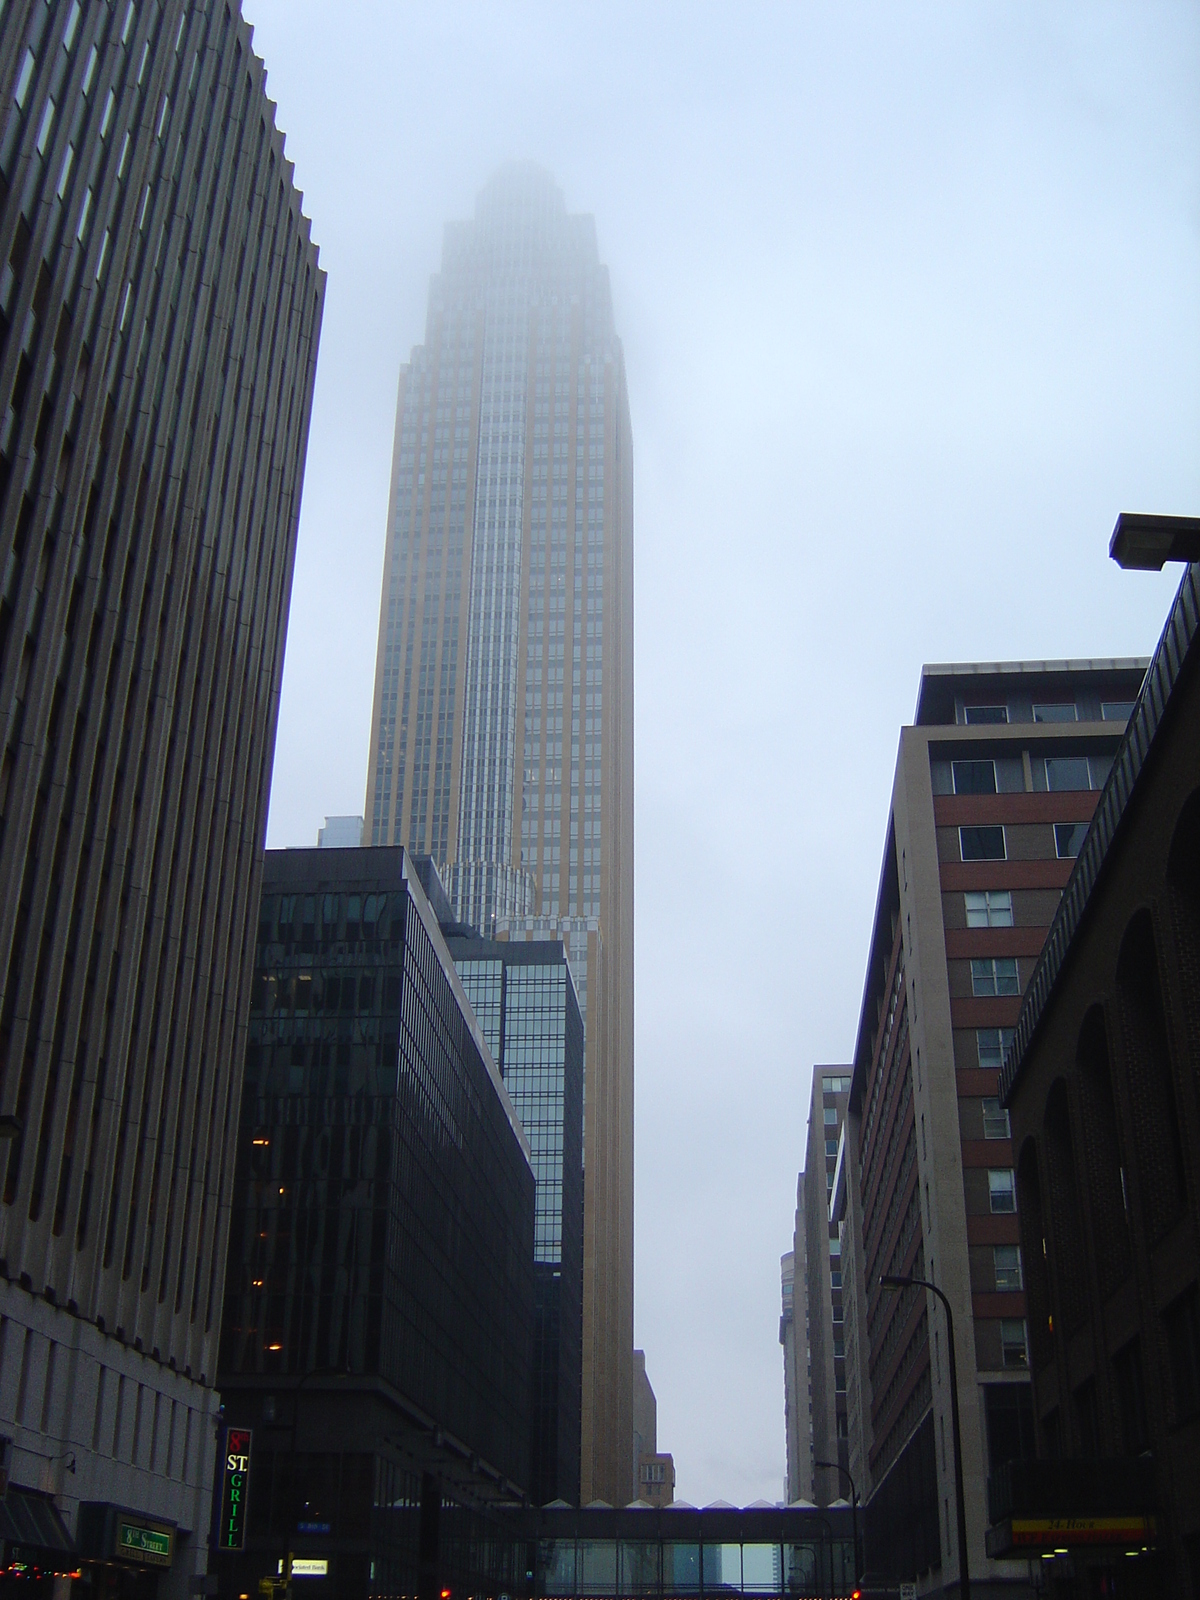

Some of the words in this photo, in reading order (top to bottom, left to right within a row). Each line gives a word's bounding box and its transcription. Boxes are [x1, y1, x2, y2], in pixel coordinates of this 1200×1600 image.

[227, 1454, 248, 1473] ST.
[228, 1474, 242, 1547] GRILL
[140, 1532, 163, 1551] STREET
